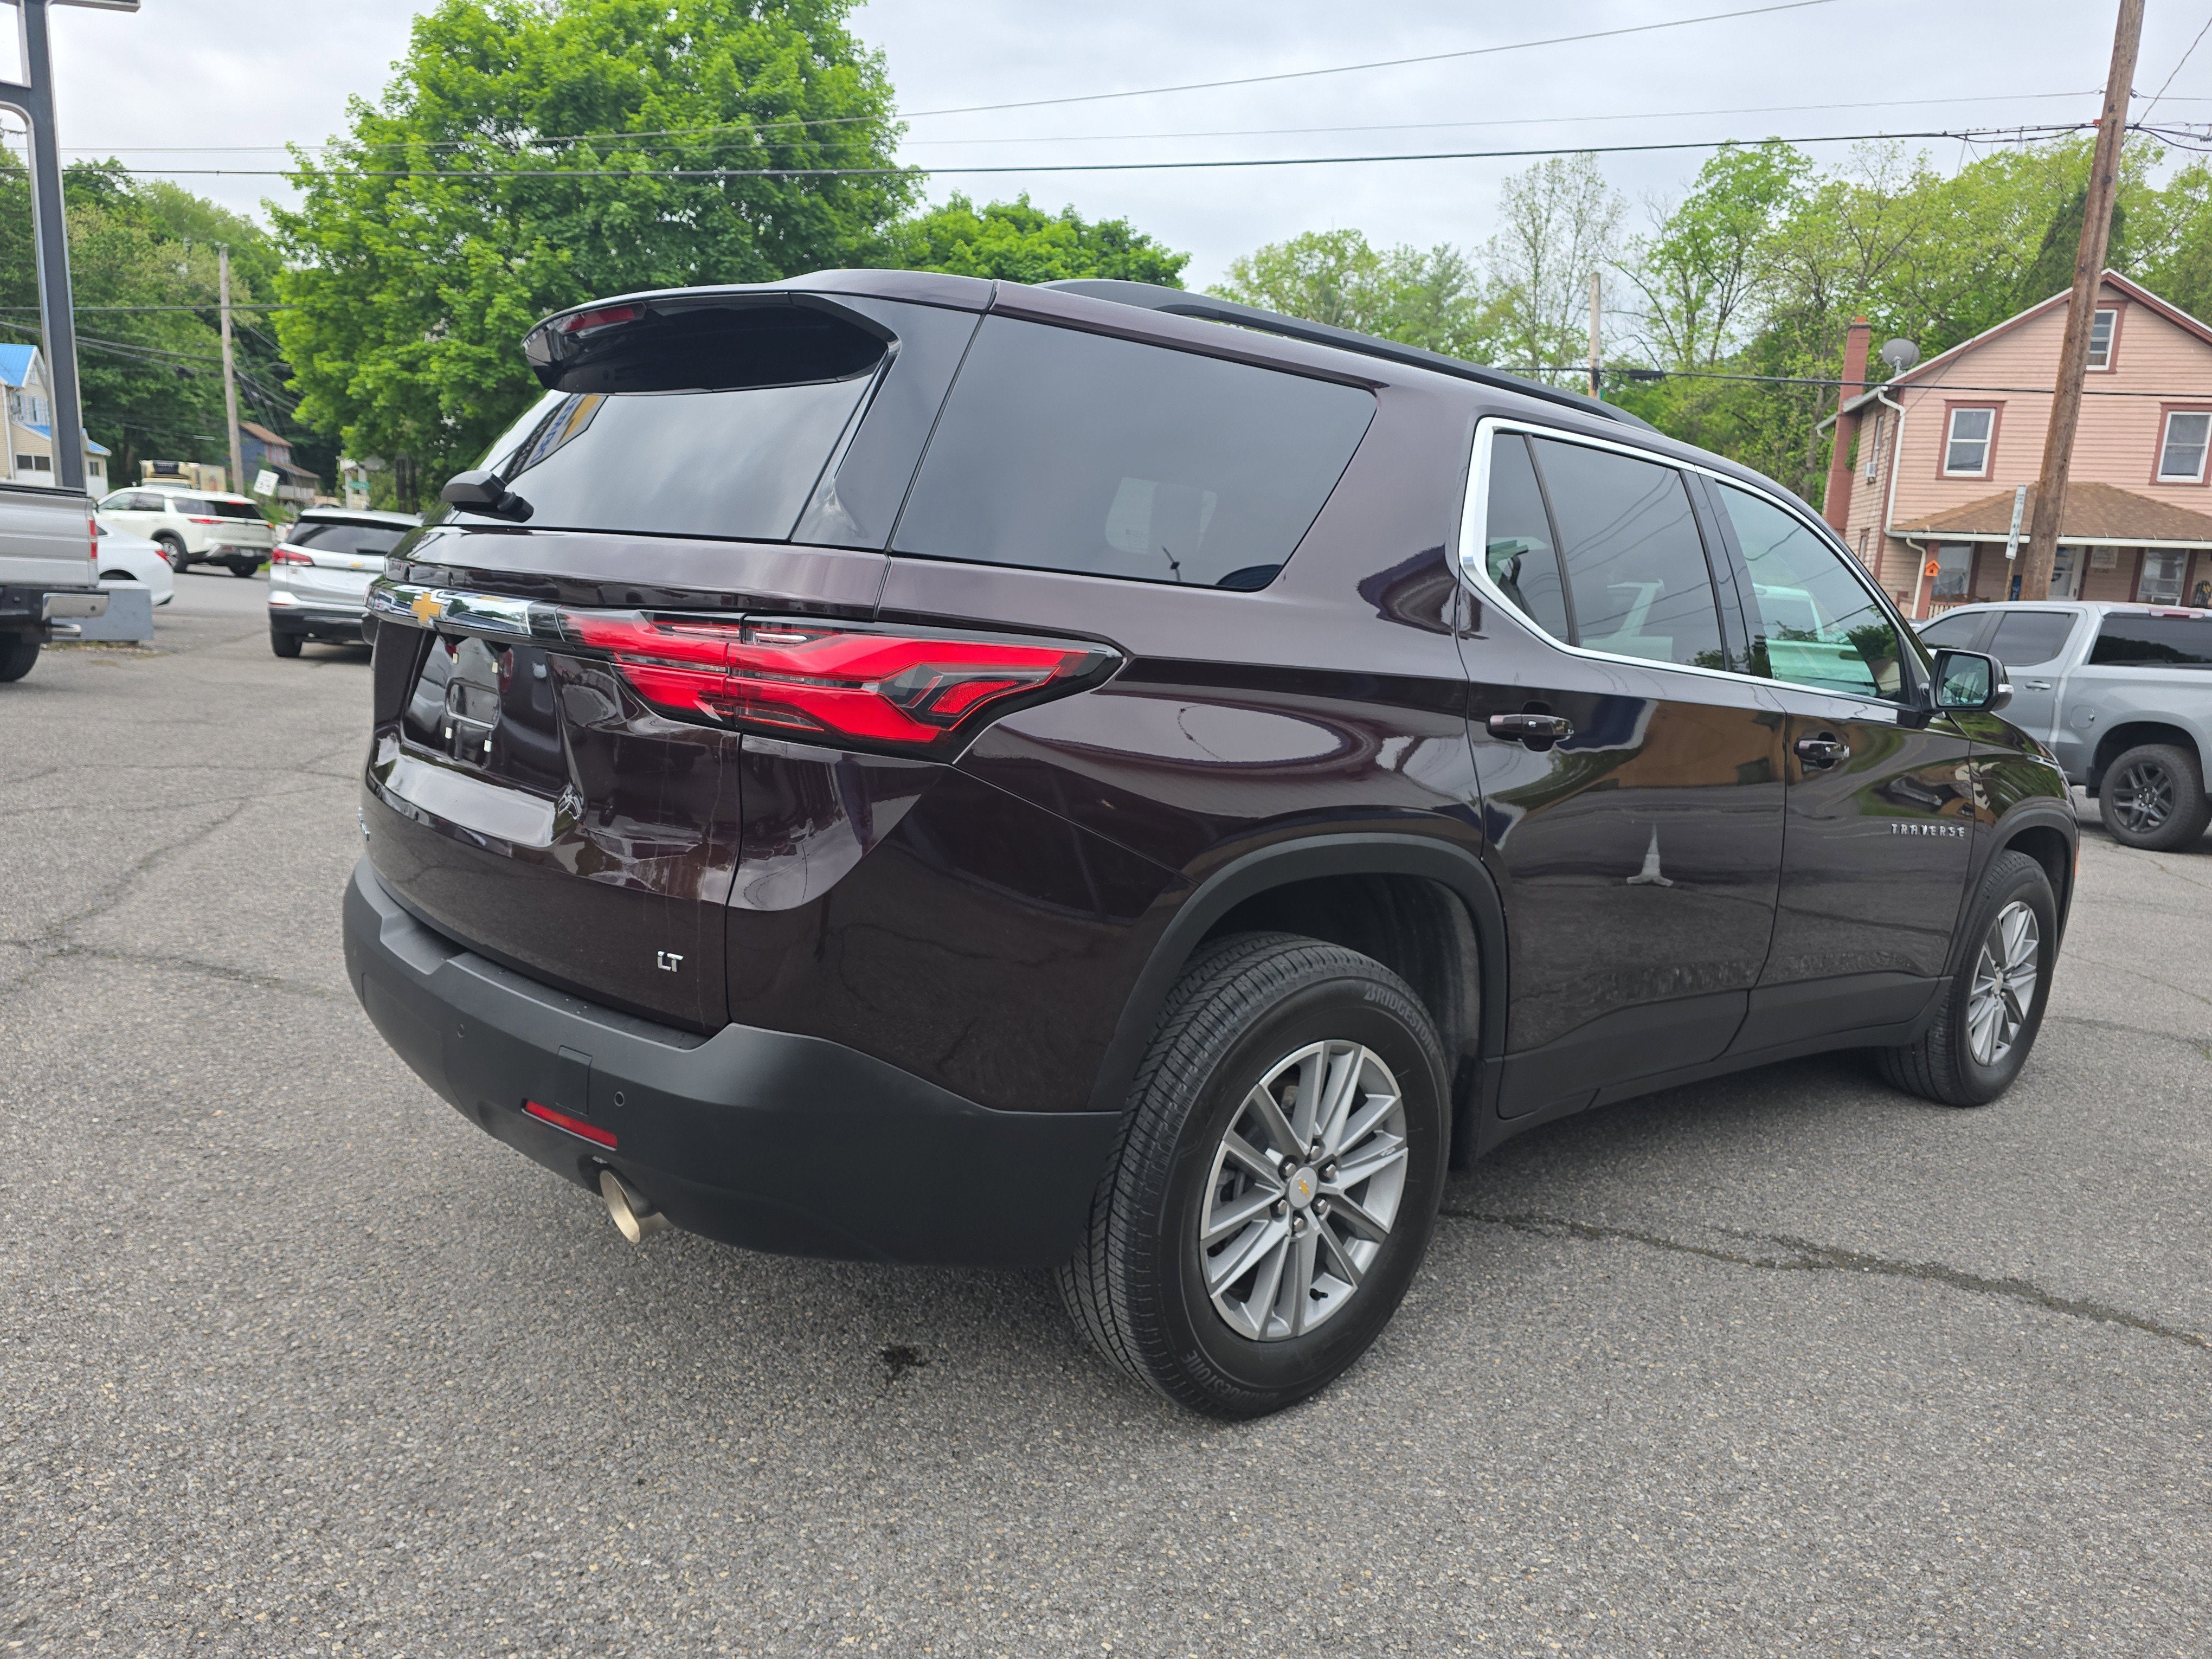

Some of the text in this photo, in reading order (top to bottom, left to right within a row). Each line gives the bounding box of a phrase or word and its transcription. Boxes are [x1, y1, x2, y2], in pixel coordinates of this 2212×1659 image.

[1891, 824, 1965, 837] TRAVERSE
[657, 951, 684, 972] LT
[1364, 982, 1438, 1058] BRIDGESTONE
